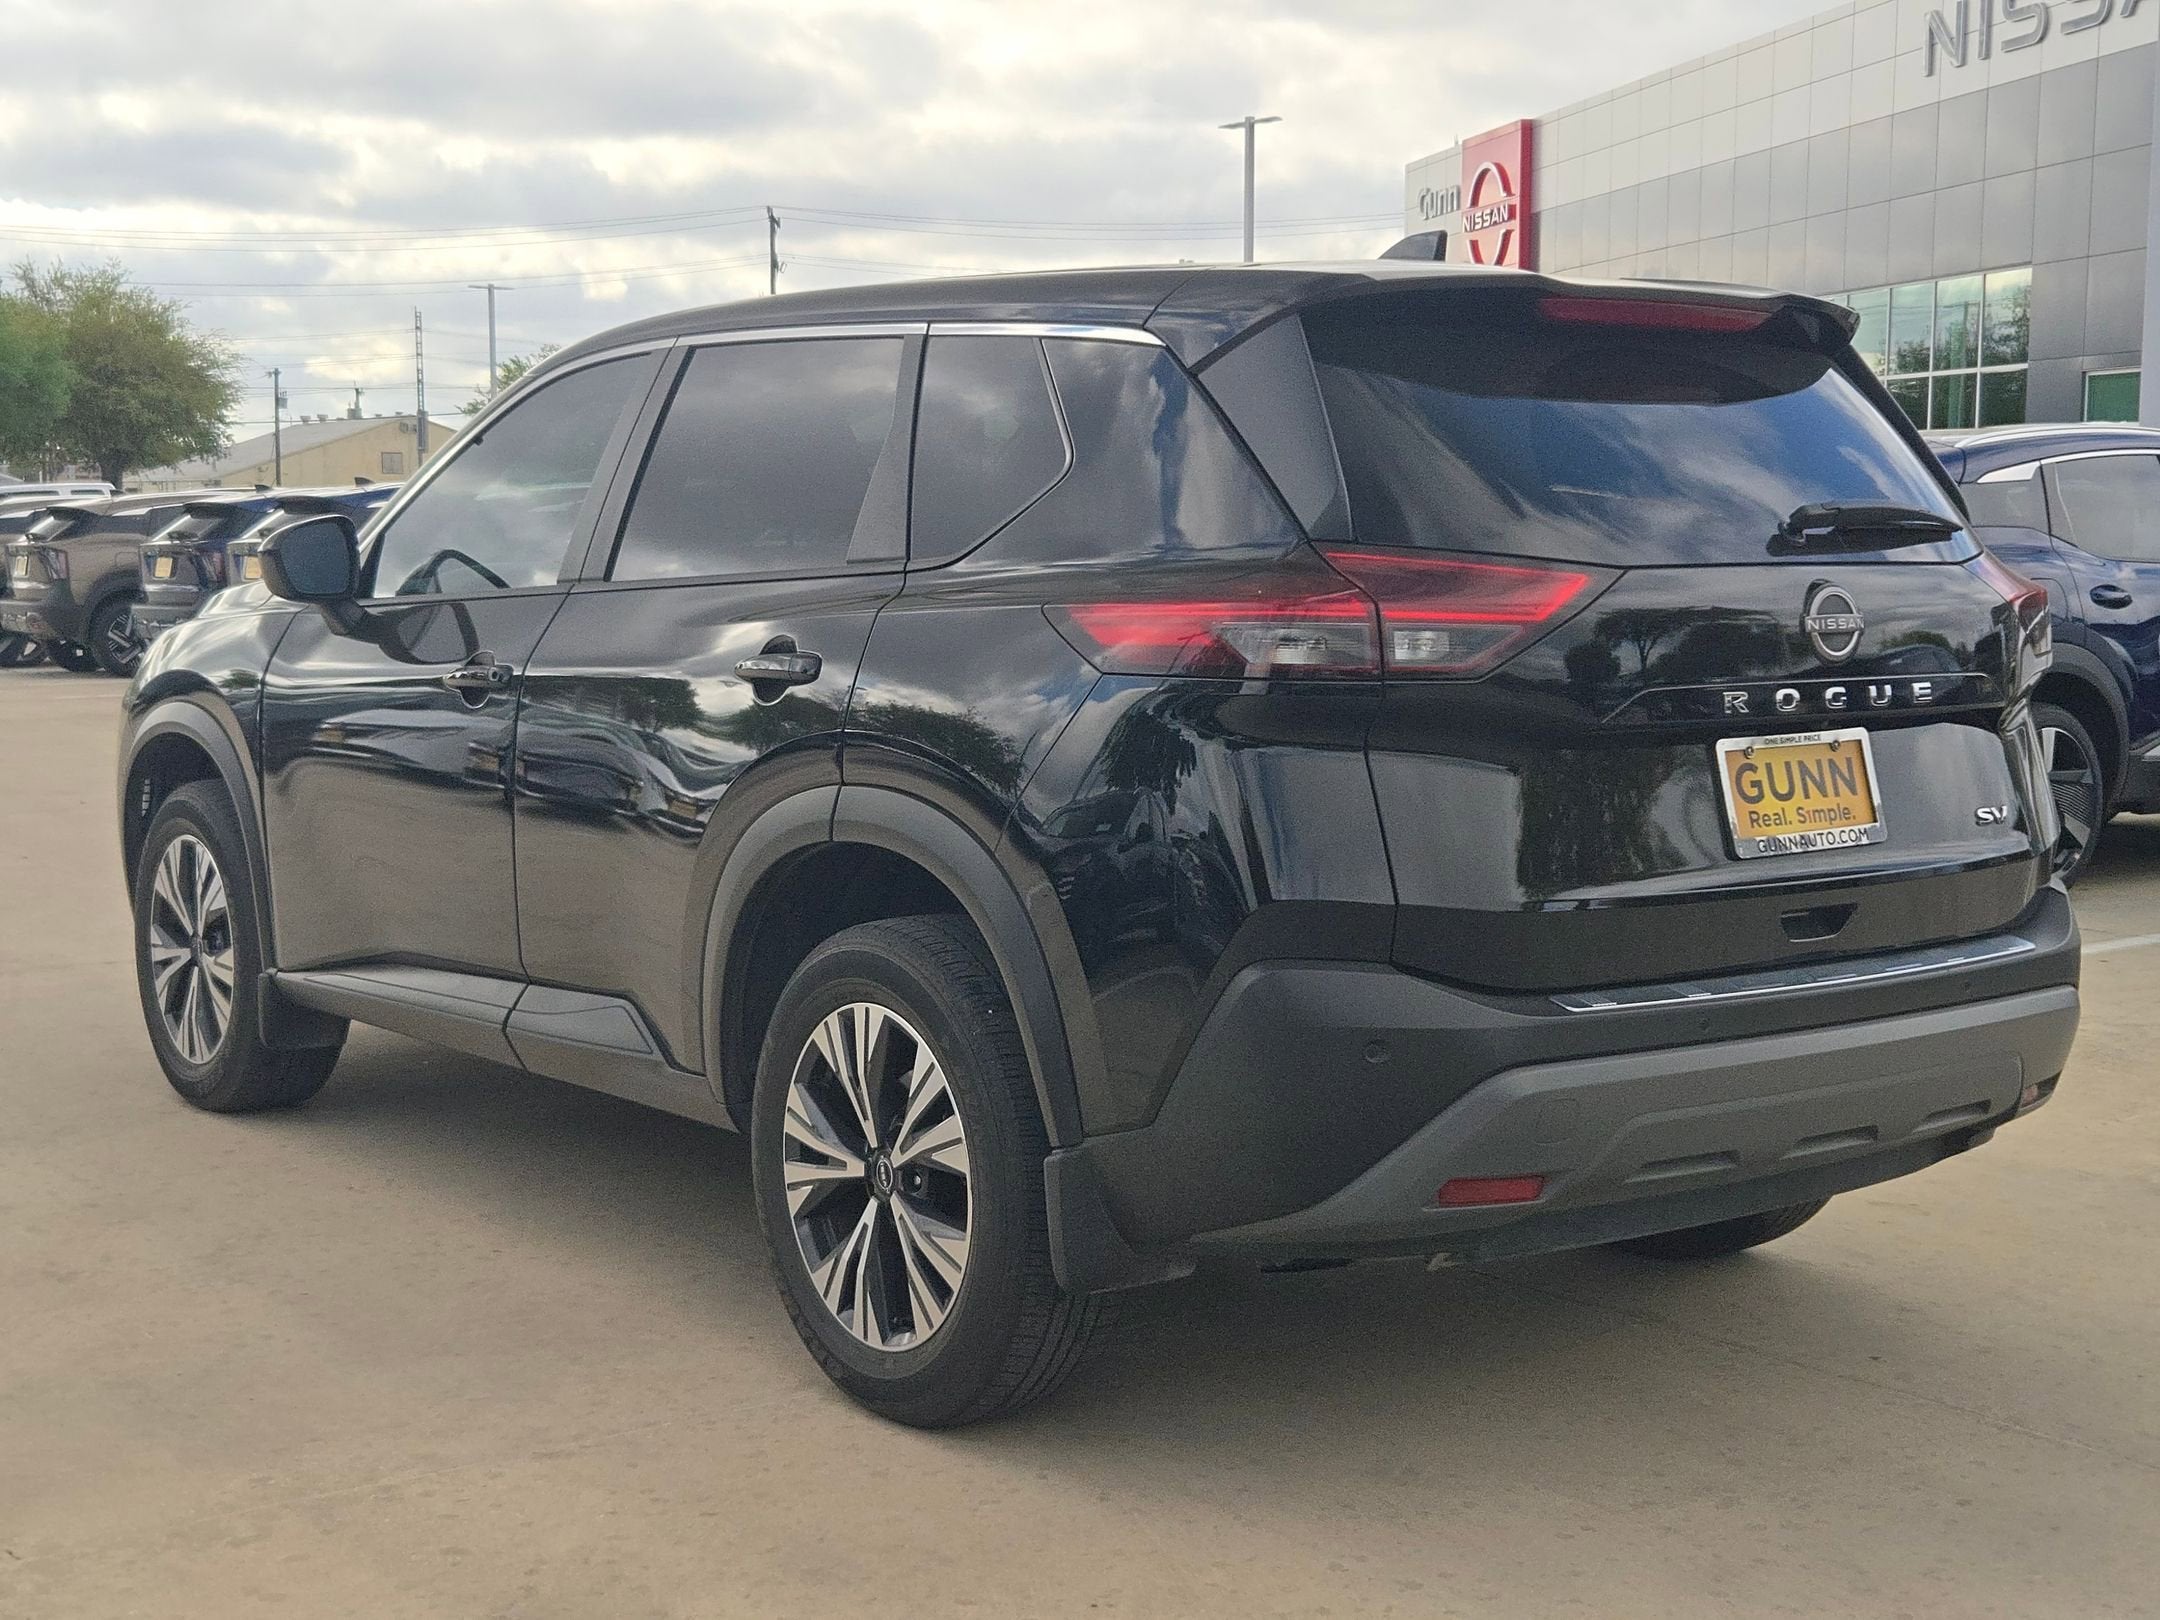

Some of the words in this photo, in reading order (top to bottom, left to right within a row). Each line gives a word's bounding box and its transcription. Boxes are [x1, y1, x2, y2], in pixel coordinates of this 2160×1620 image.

[1924, 0, 2138, 77] NIS
[1418, 185, 1461, 220] Gunn
[1462, 202, 1509, 233] NISSAN
[1806, 615, 1864, 632] NISSAN
[1723, 681, 1933, 714] ROGUE
[1735, 756, 1858, 805] GUNN
[1749, 807, 1792, 829] Real.
[1796, 804, 1856, 825] Simple.
[1975, 805, 2008, 826] SV
[1757, 828, 1869, 854] GUNNAUTO.COM
